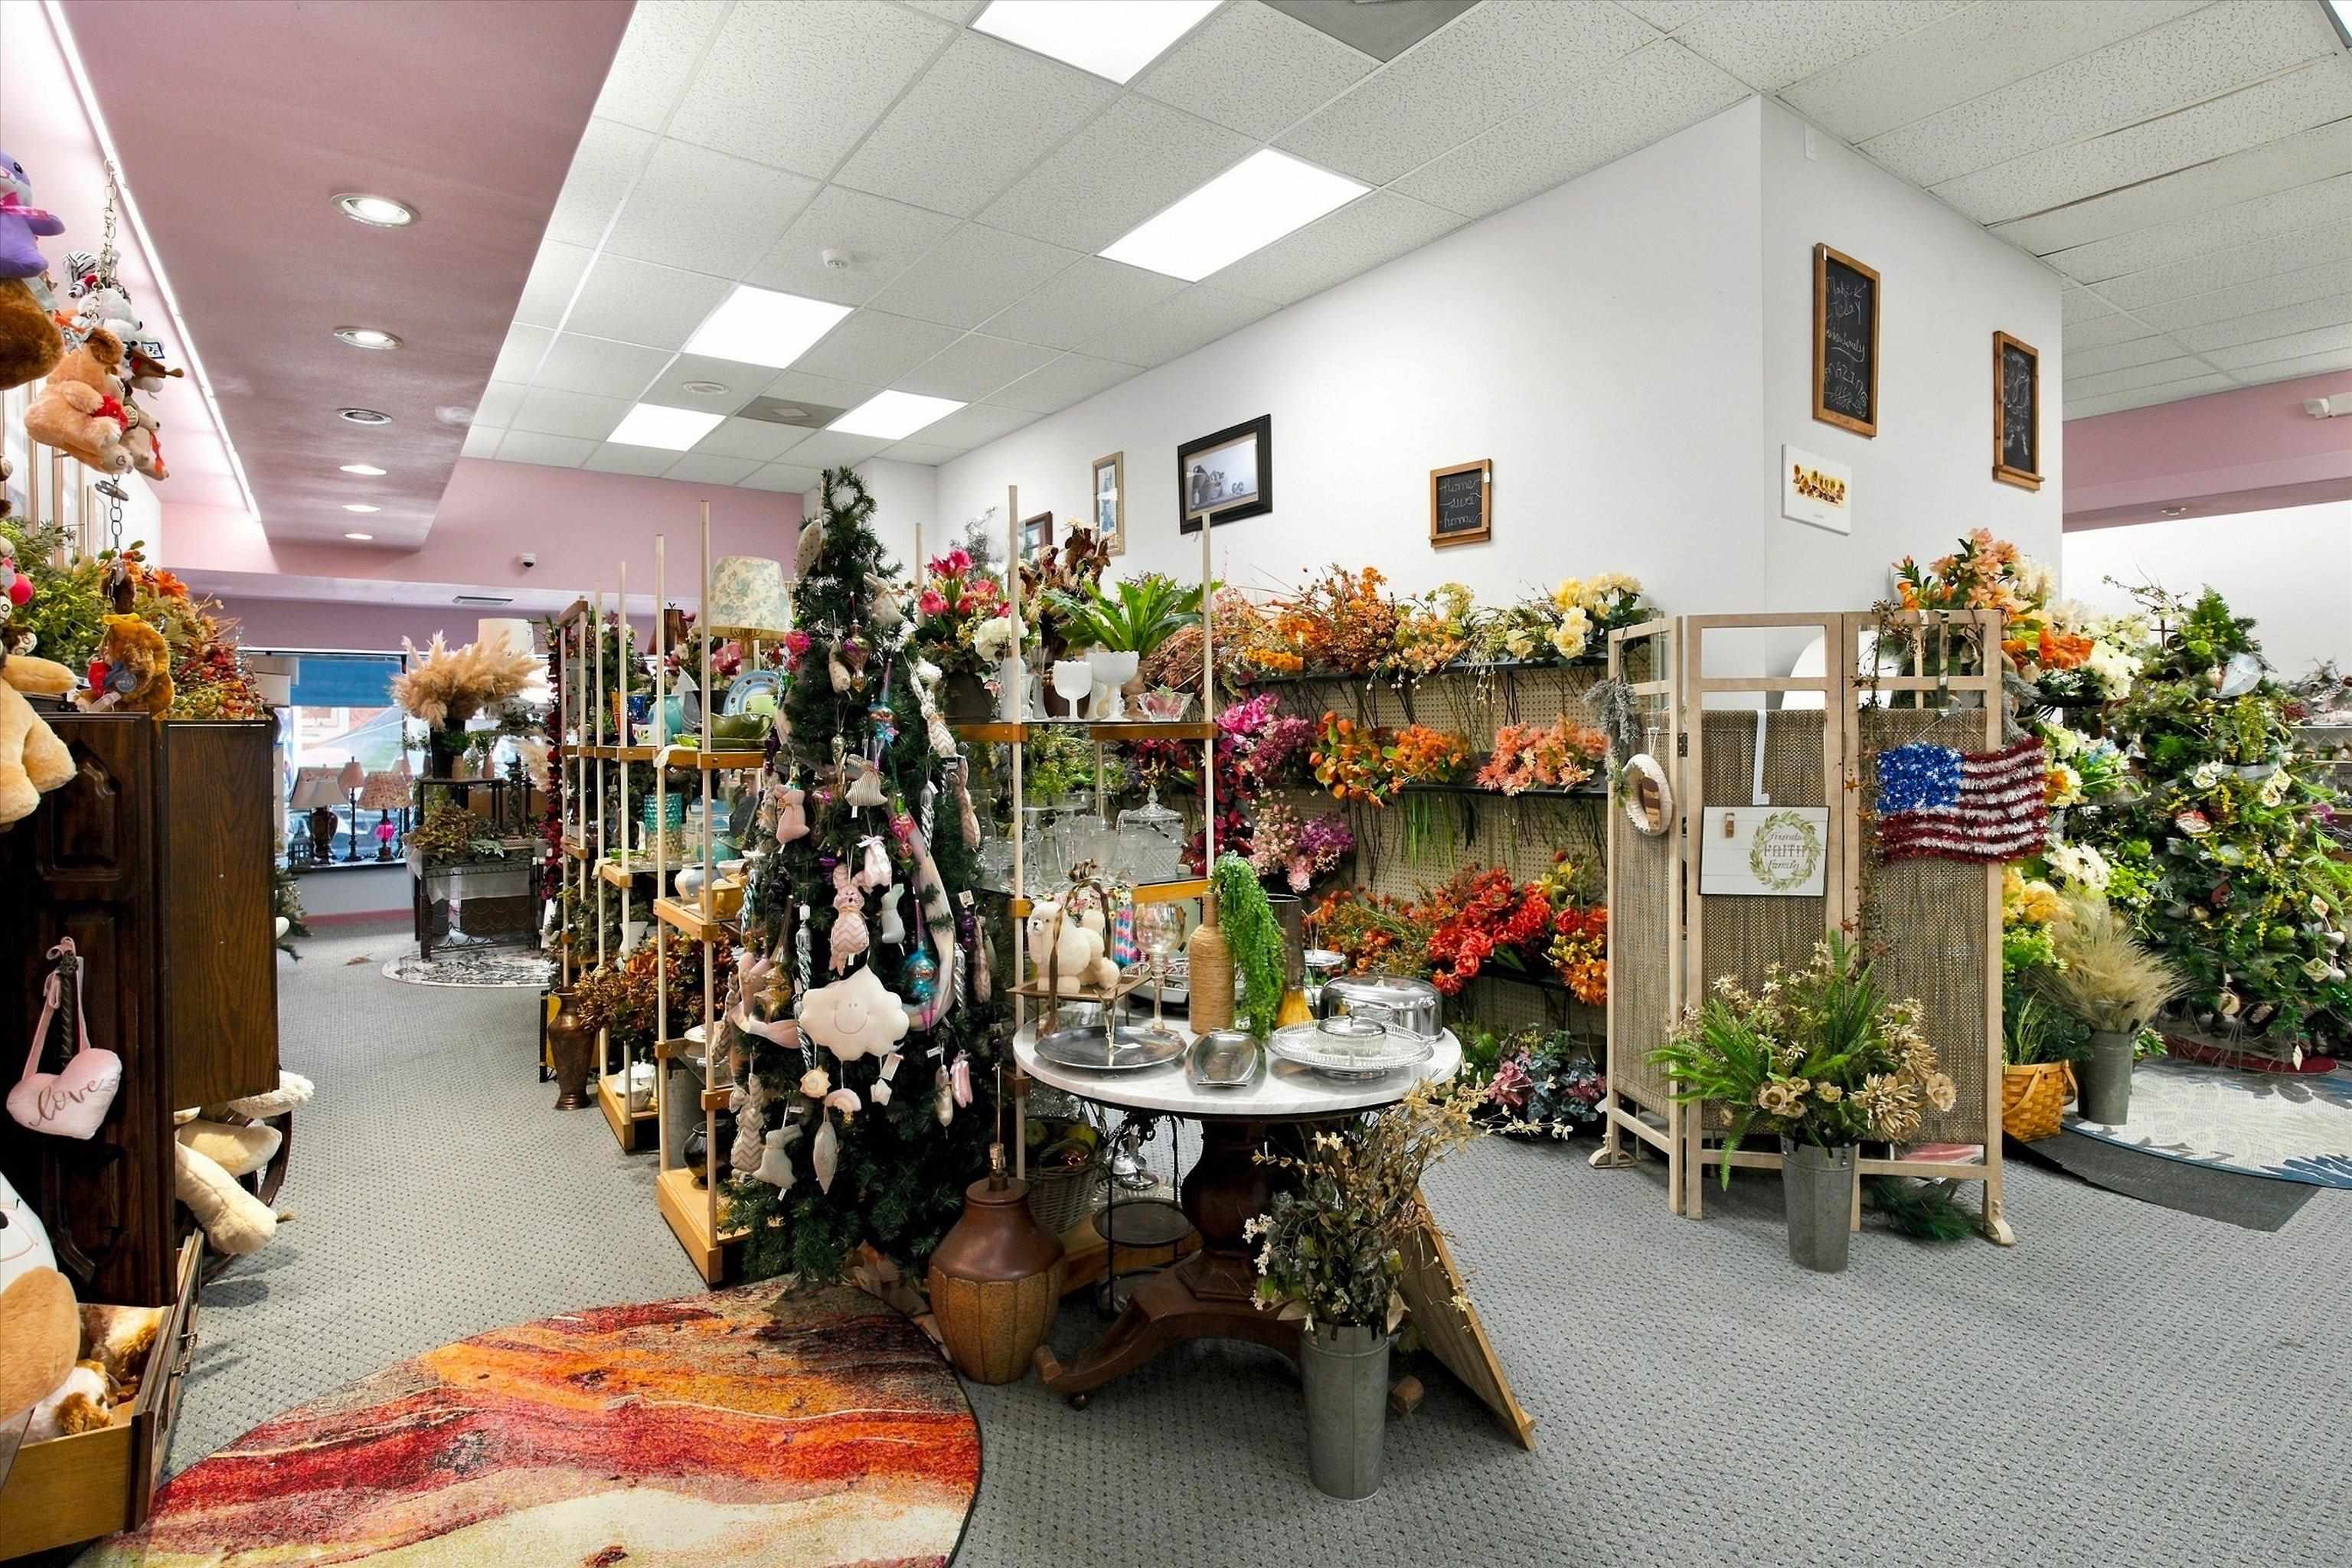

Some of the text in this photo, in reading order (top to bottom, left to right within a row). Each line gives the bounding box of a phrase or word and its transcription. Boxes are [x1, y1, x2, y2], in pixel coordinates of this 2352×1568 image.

[1439, 478, 1483, 495] home
[1440, 511, 1483, 528] home
[1763, 844, 1806, 858] FAITH
[1766, 859, 1801, 871] family
[29, 1078, 105, 1127] love
